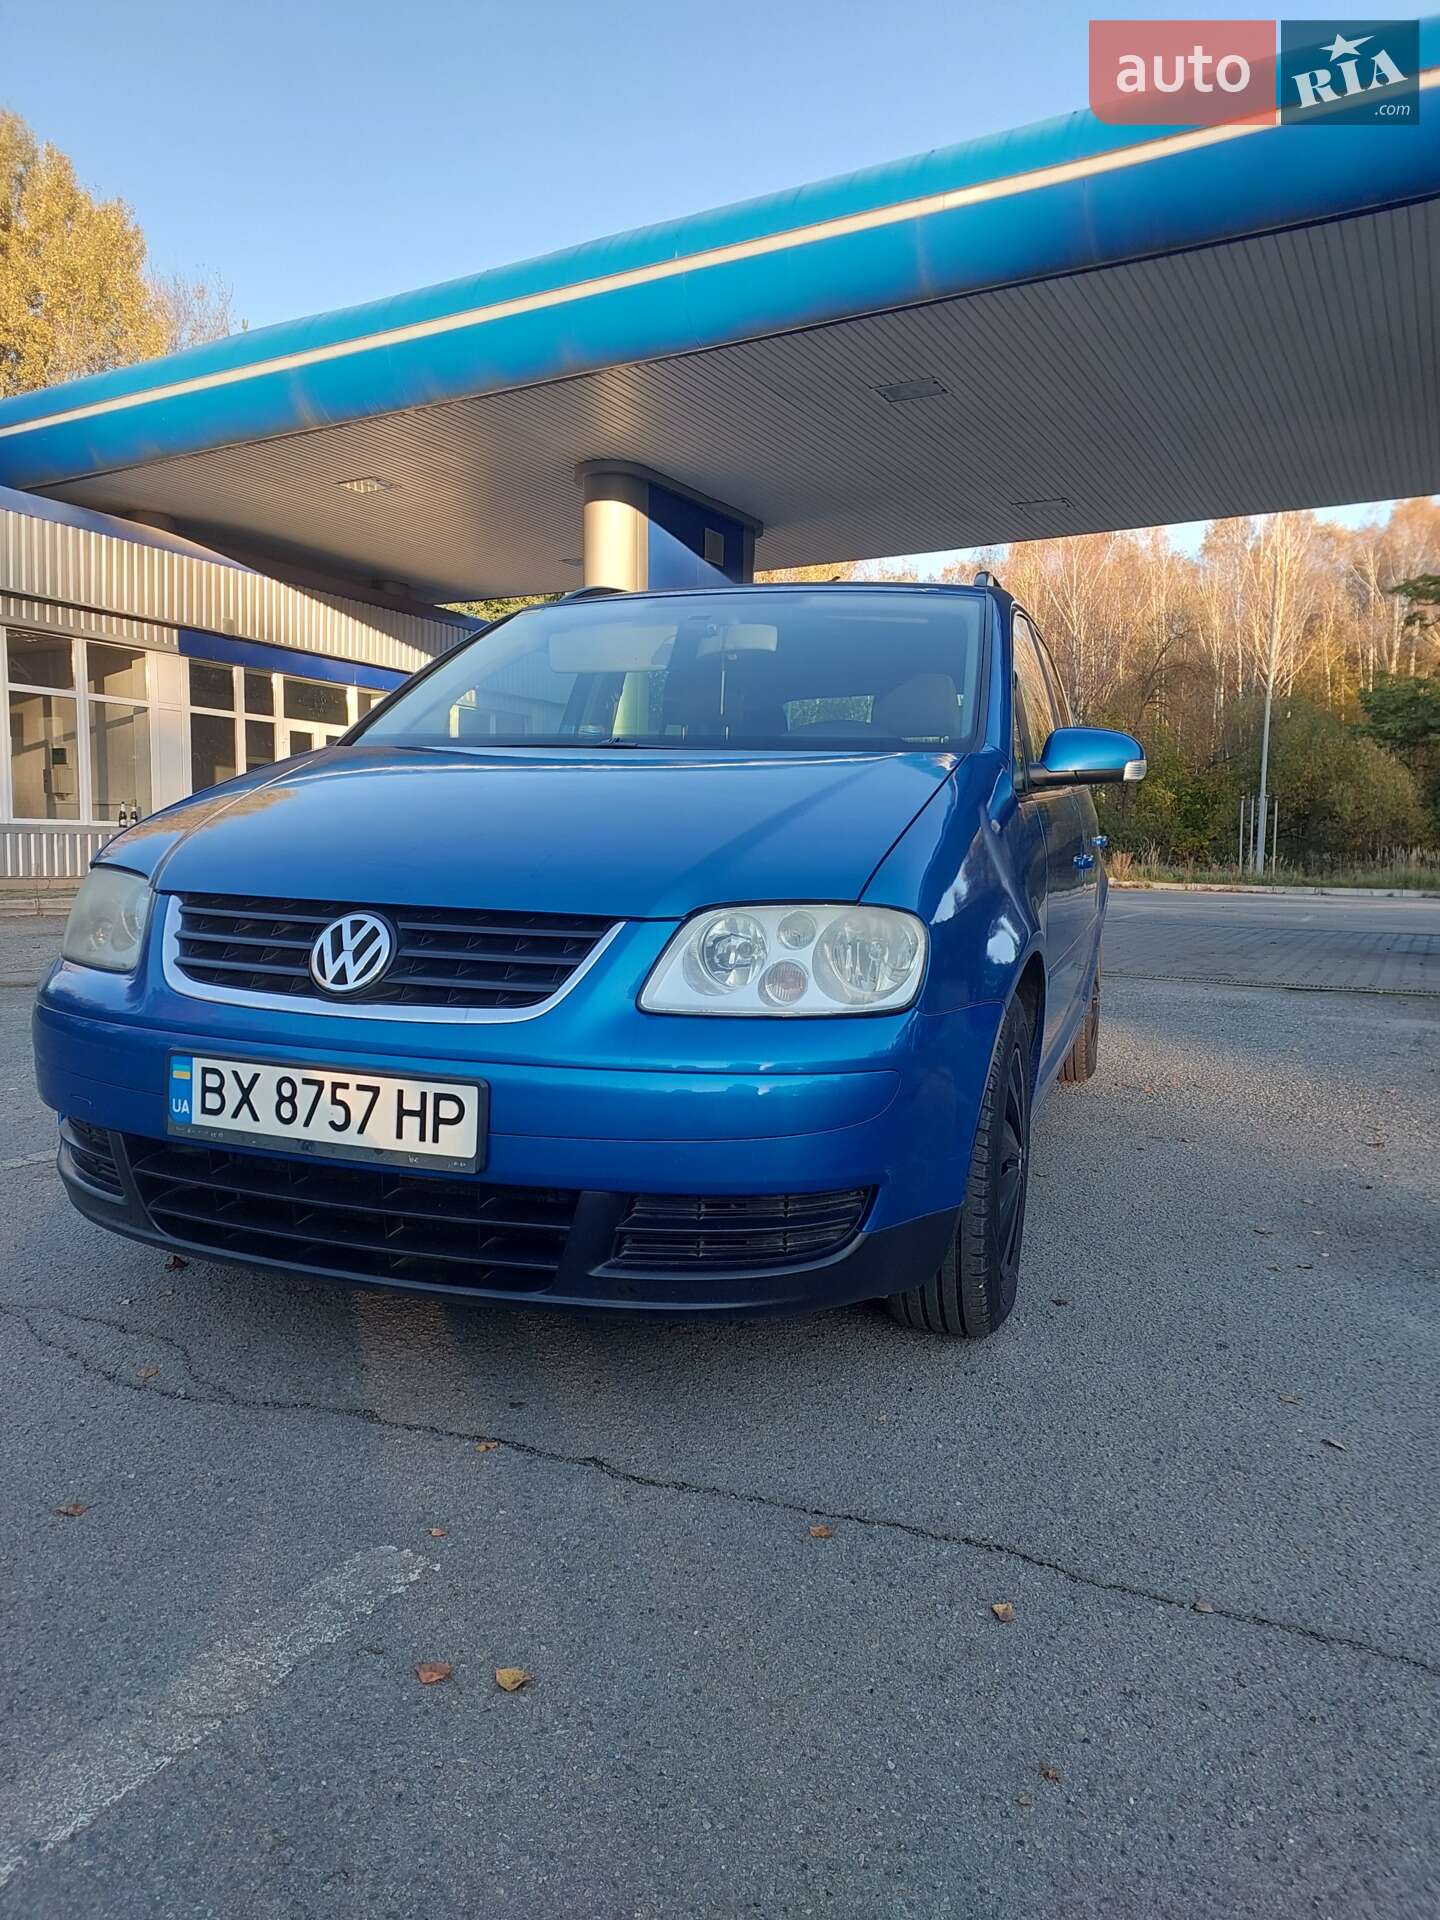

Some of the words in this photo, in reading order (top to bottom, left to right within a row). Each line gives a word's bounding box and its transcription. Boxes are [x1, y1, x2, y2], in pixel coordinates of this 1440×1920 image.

[311, 913, 390, 990] VW
[172, 1099, 190, 1114] UA
[201, 1067, 261, 1122] BX
[275, 1076, 380, 1135] 8757
[396, 1089, 465, 1143] HP
